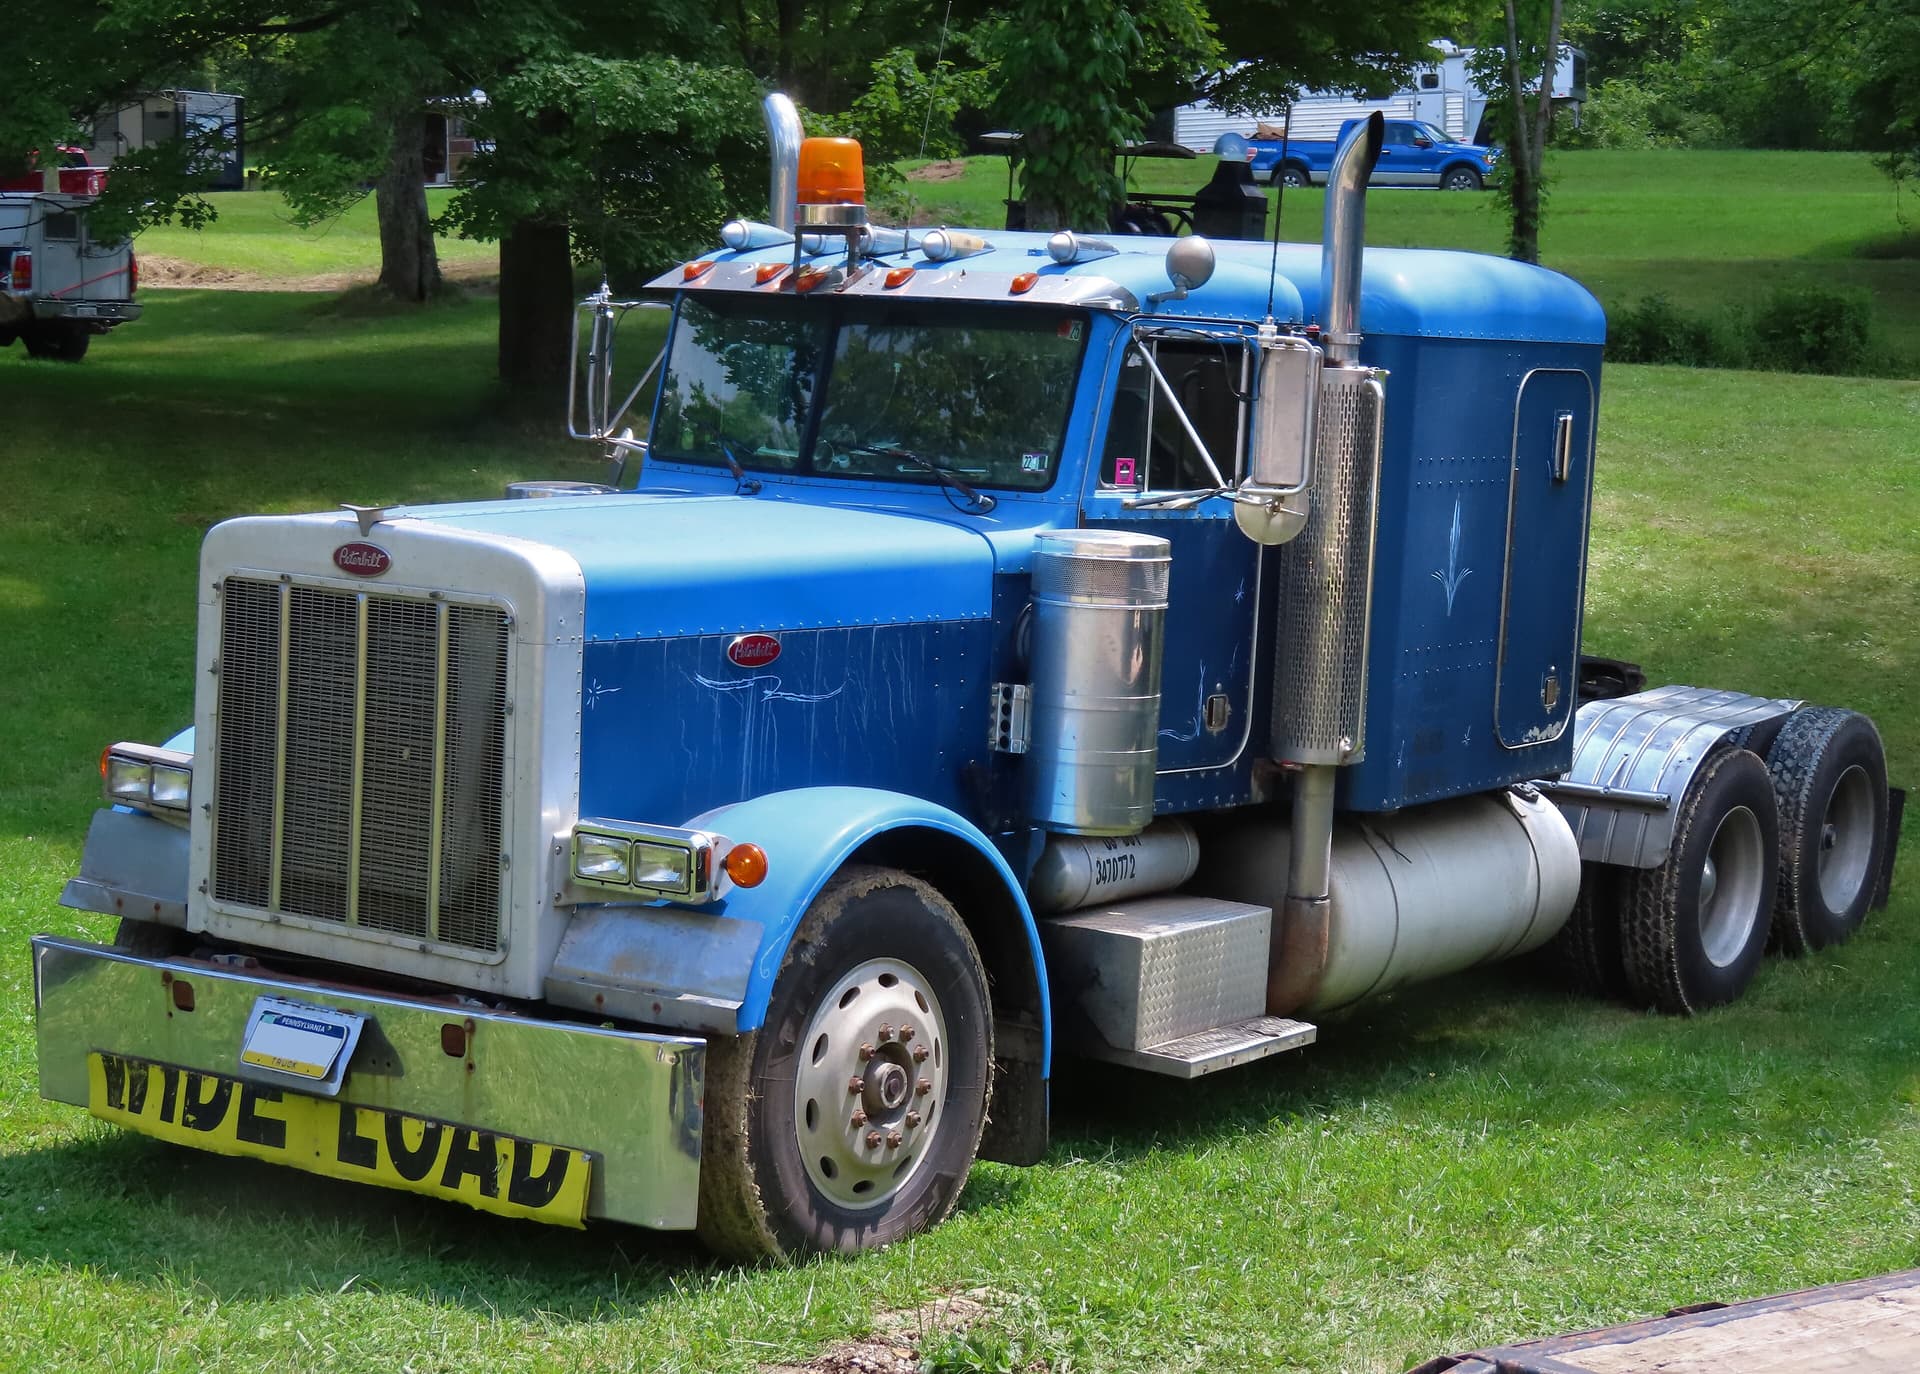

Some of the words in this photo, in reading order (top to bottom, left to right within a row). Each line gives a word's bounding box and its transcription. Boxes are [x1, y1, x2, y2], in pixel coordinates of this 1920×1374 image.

[339, 547, 386, 568] Peterbilt
[1095, 854, 1136, 886] 3470772
[281, 1016, 325, 1033] PENNSYLVANIA
[272, 1056, 297, 1069] TRUCK
[100, 1055, 287, 1149] WIDE
